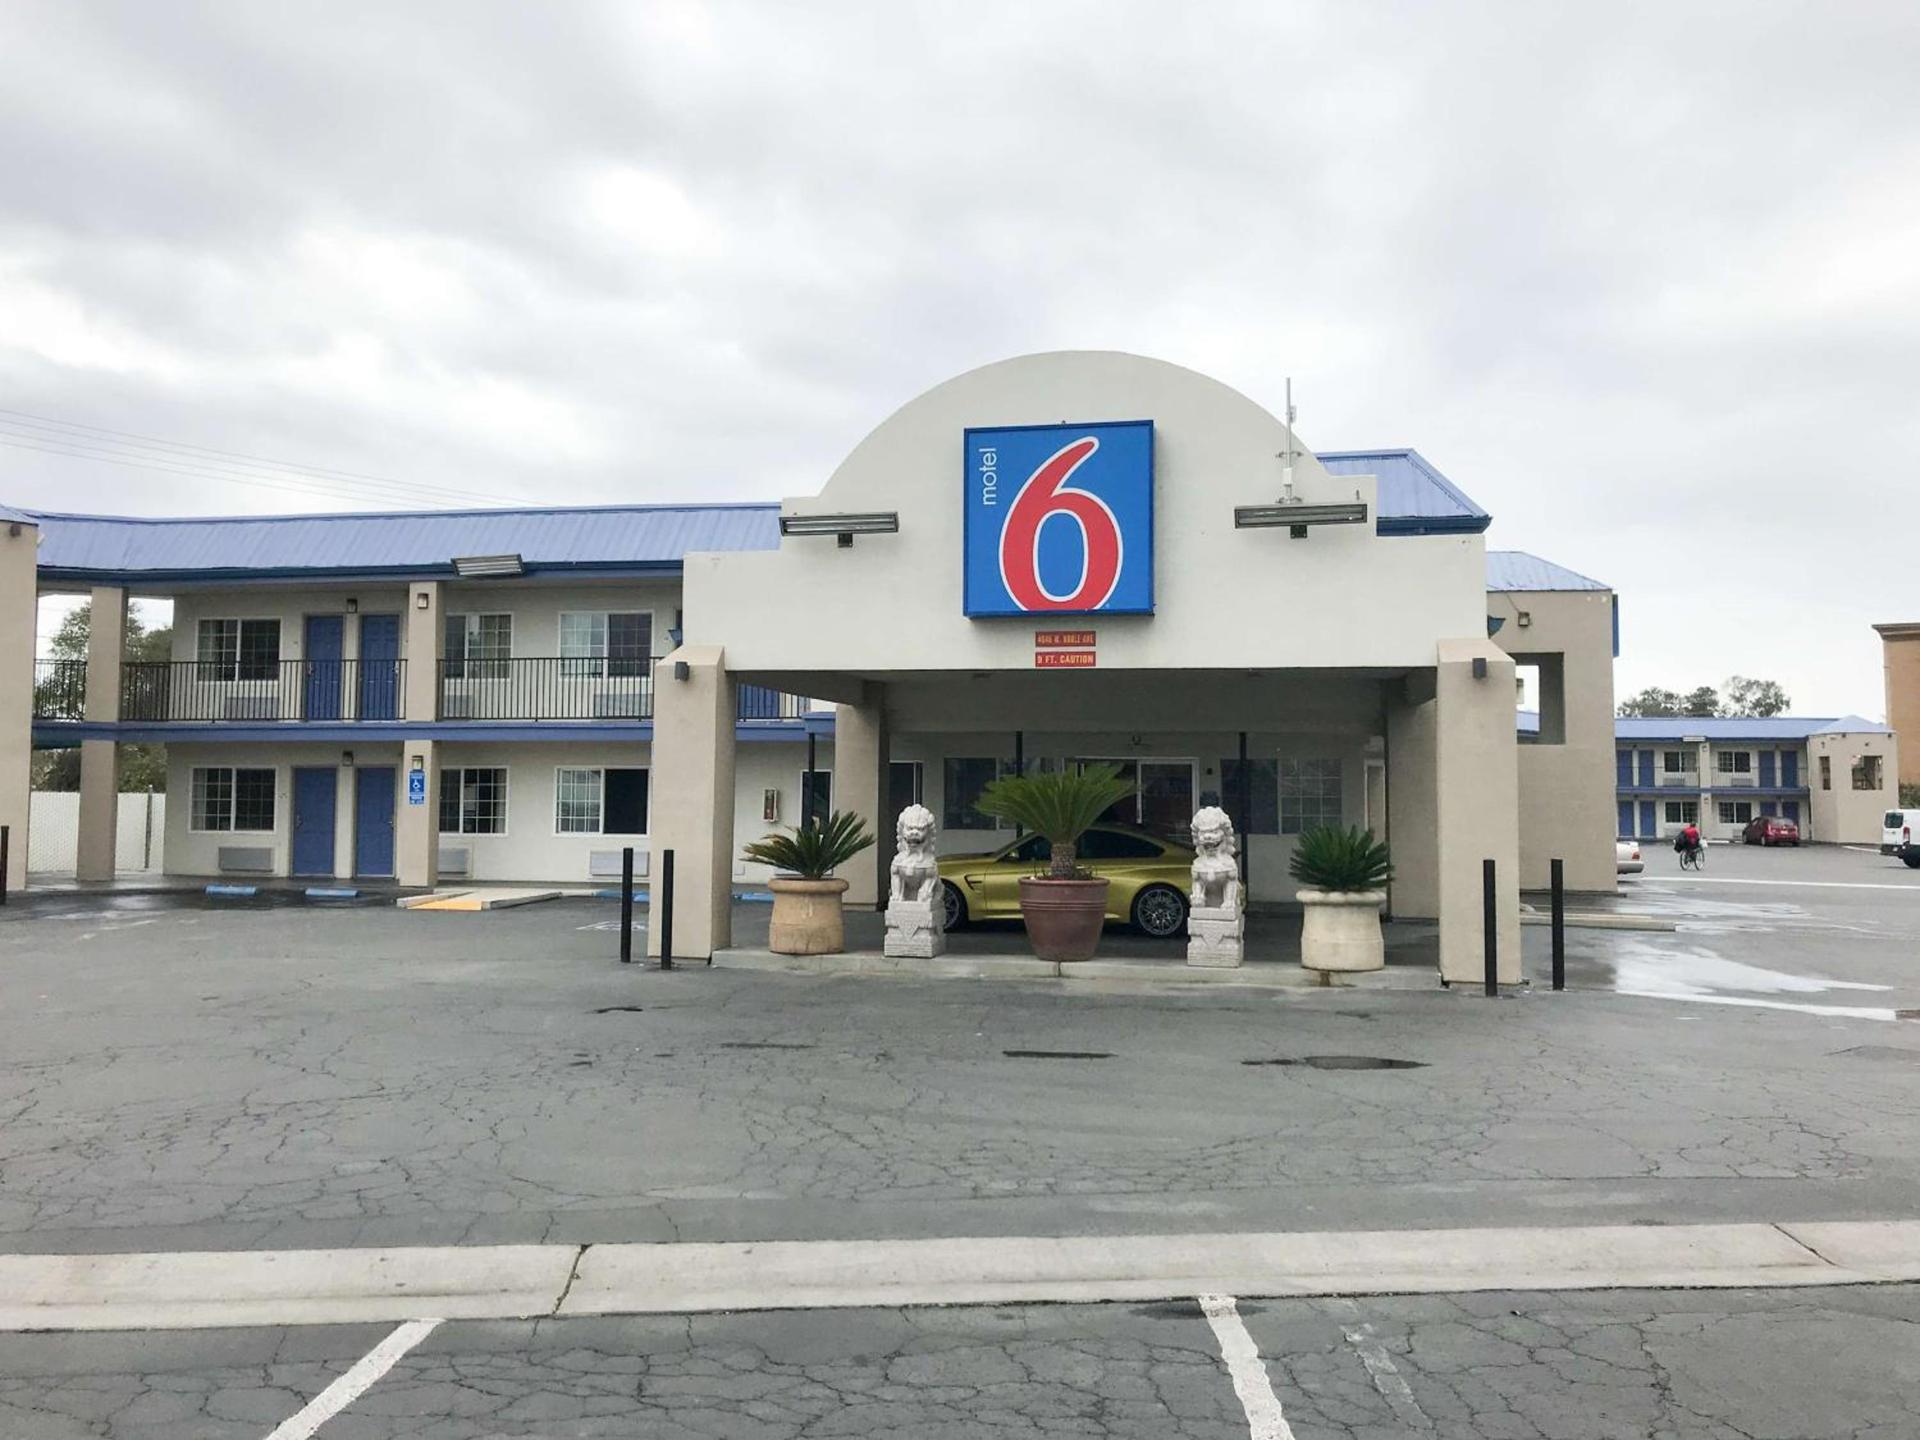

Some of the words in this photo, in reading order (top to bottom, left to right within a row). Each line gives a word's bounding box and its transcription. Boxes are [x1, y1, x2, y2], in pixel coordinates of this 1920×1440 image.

[979, 448, 997, 505] motel
[999, 436, 1123, 611] 6
[1045, 655, 1057, 664] FT.
[1059, 654, 1094, 664] CAUTION
